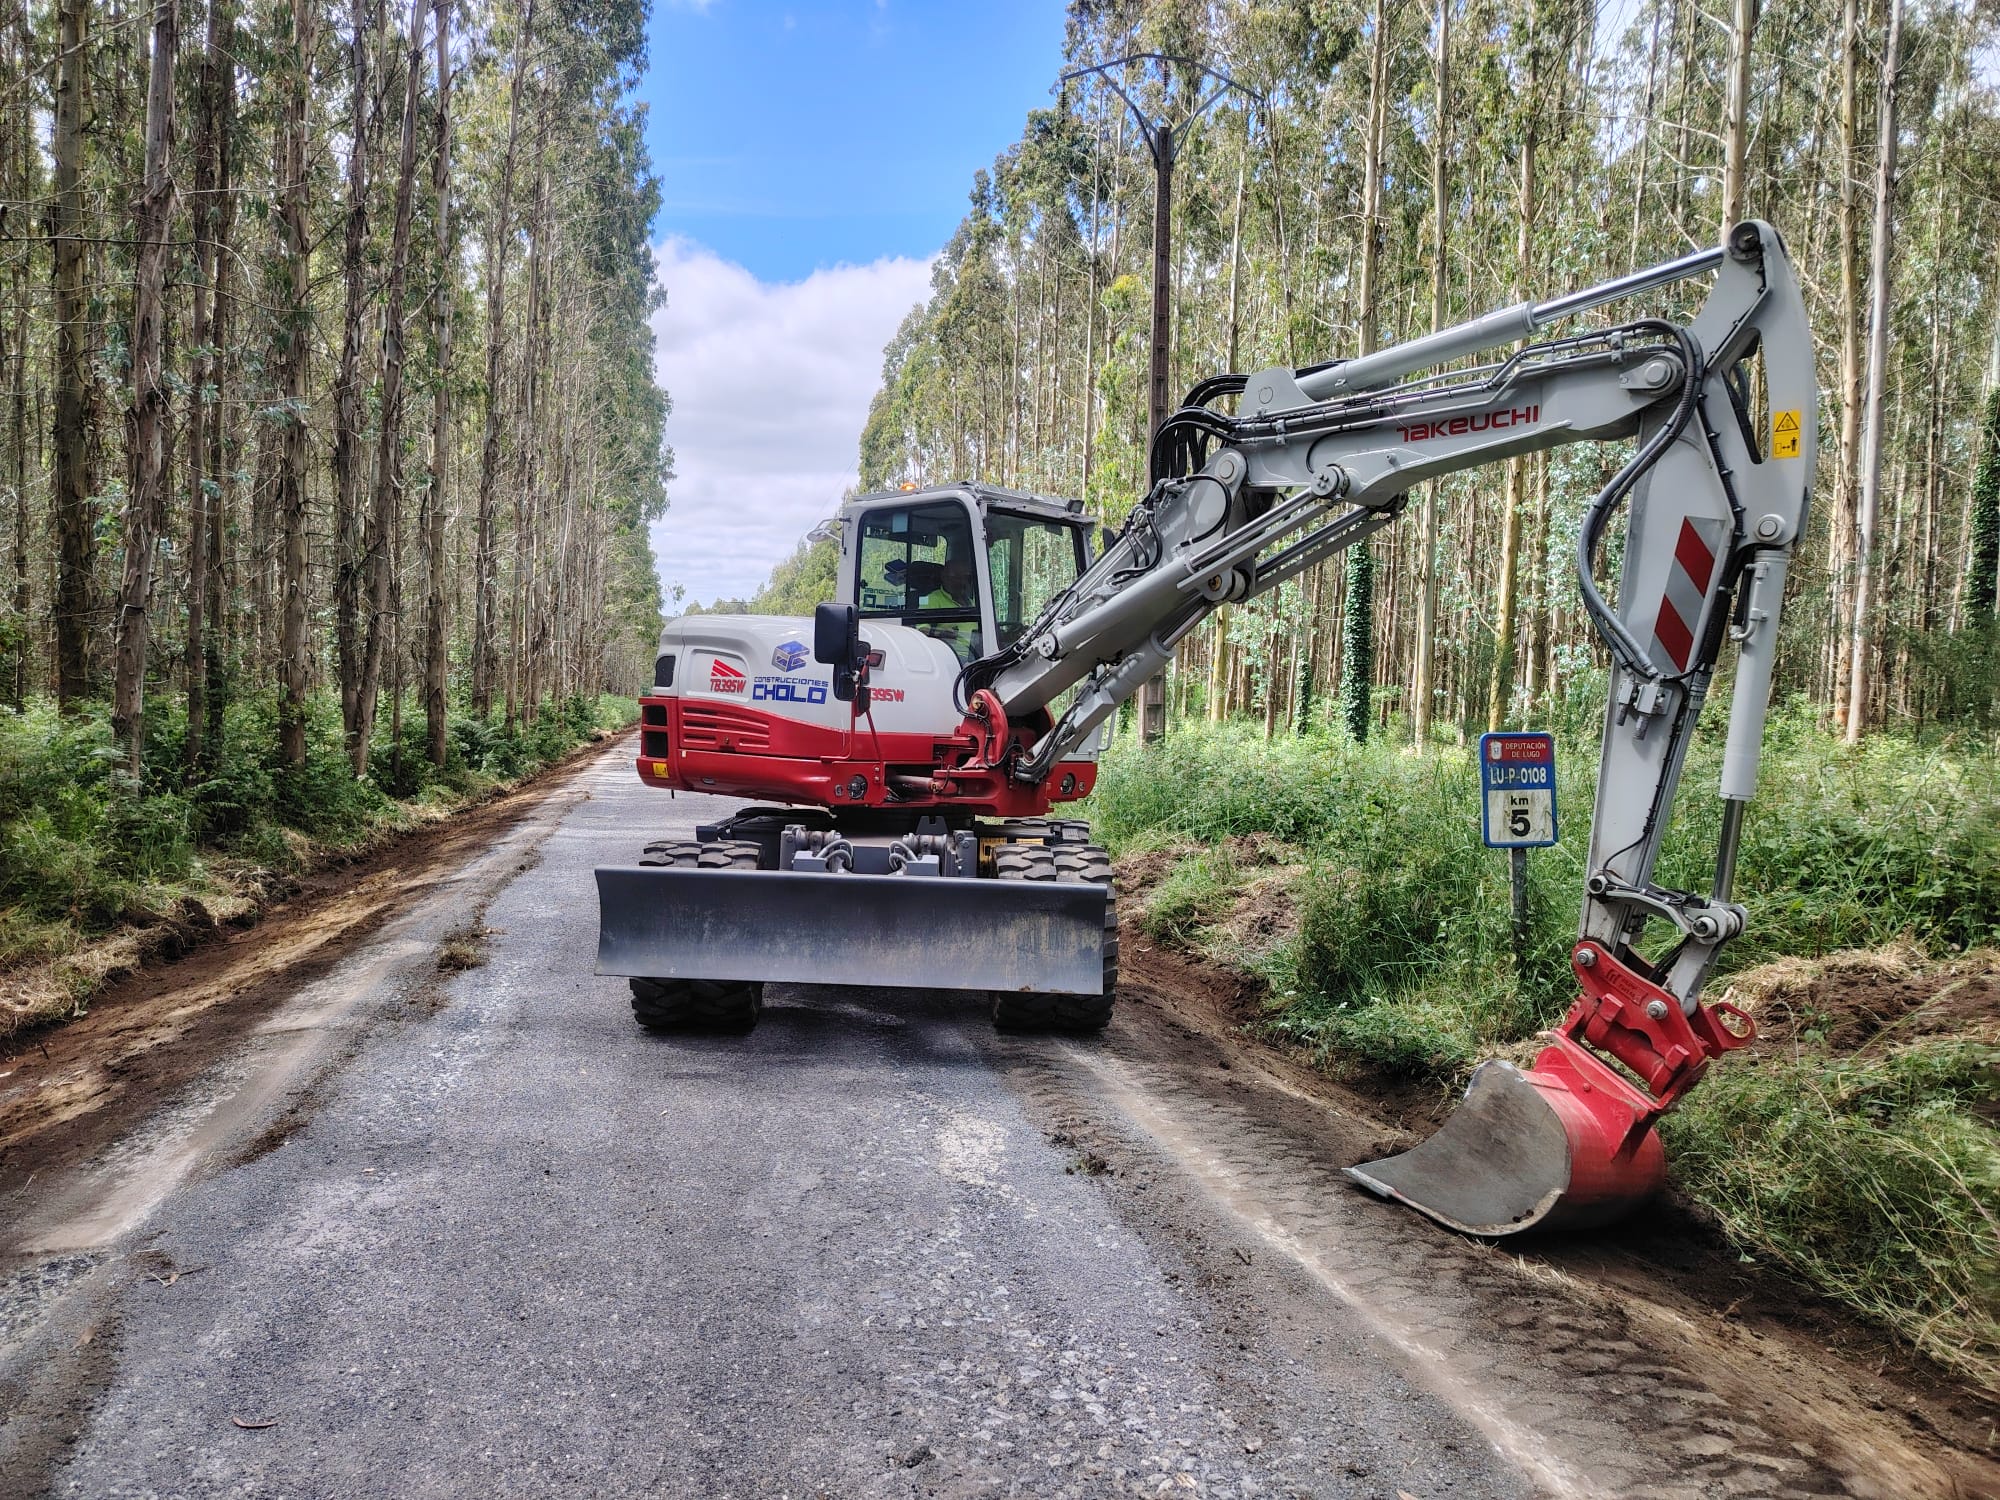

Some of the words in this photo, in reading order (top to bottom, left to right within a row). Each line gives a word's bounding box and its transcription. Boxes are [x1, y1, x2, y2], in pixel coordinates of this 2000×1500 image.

[710, 678, 747, 693] TB395W
[754, 676, 829, 688] CONSTRUCCIONES
[752, 684, 828, 704] CHOLO
[870, 687, 905, 702] 395W
[1490, 767, 1547, 784] LU-P-0108
[1510, 796, 1529, 805] km
[1510, 809, 1531, 837] 5
